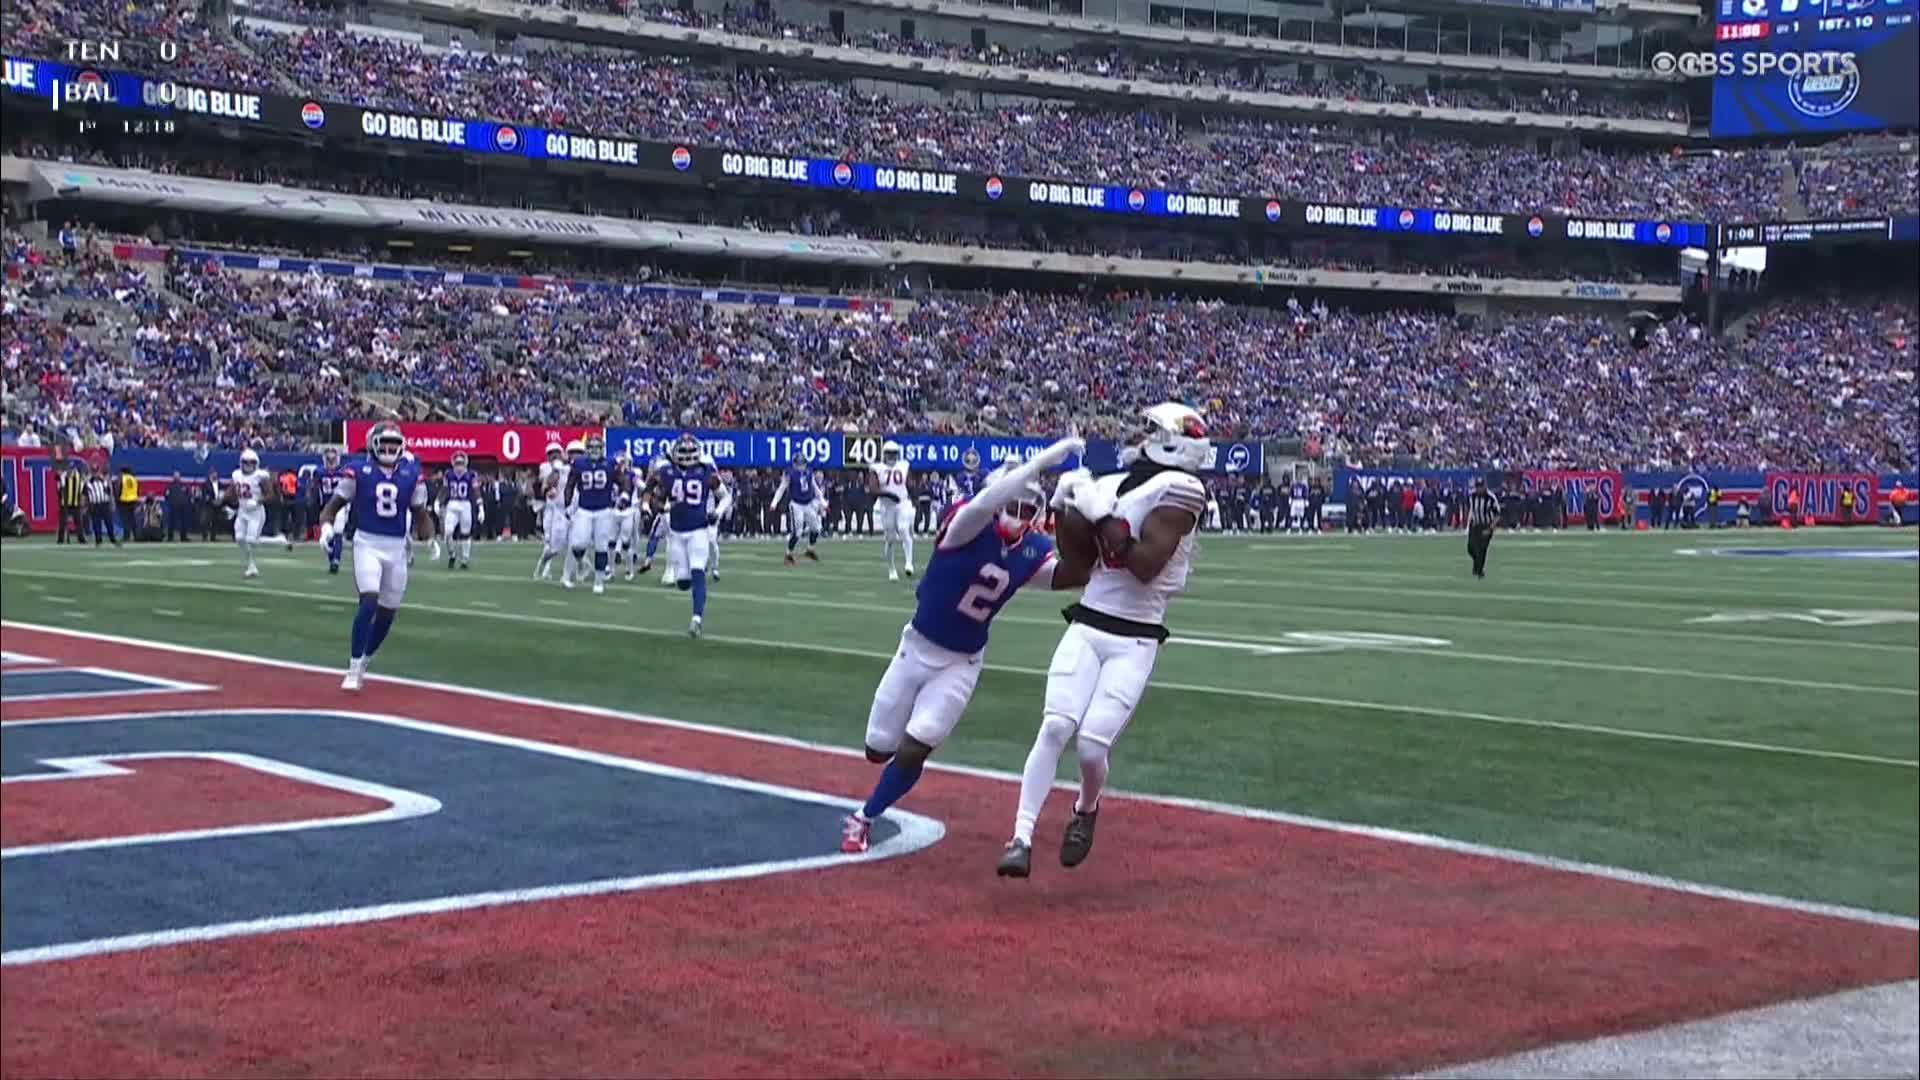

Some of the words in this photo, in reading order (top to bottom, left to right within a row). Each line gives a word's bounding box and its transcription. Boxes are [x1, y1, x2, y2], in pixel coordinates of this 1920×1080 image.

[0, 57, 36, 89] UE
[210, 90, 261, 121] BLUE
[361, 111, 387, 136] GO
[389, 114, 419, 140] BIG
[420, 118, 467, 147] BLUE
[545, 133, 569, 156] GO
[570, 136, 597, 160] BIG
[598, 139, 639, 165] BLUE
[721, 152, 743, 175] GO
[744, 155, 770, 177] BIG
[771, 157, 809, 181] BLUE
[875, 168, 896, 189] GO
[896, 169, 921, 191] BIG
[921, 172, 958, 195] BLUE
[1029, 182, 1048, 202] GO
[1049, 184, 1071, 204] BIG
[1071, 186, 1106, 208] BLUE
[1166, 193, 1185, 213] GO
[1186, 195, 1207, 215] BIG
[1207, 197, 1241, 218] BLUE
[1305, 204, 1324, 223] GO
[1324, 205, 1345, 224] BIG
[1346, 207, 1378, 227] BLUE
[1433, 213, 1451, 231] GO
[1452, 214, 1472, 232] BIG
[1472, 215, 1504, 234] BLUE
[1566, 220, 1584, 237] GO
[1584, 221, 1605, 238] BIG
[1605, 222, 1637, 241] BLUE
[406, 437, 477, 449] CARDINALS
[502, 430, 521, 461] 0
[624, 438, 656, 458] 1ST
[659, 440, 736, 459] QTER
[767, 436, 831, 463] 11:09
[849, 438, 877, 464] 40
[942, 445, 959, 461] 10
[990, 445, 1020, 462] BALL
[581, 469, 607, 490] 99
[671, 478, 703, 505] 49
[375, 481, 399, 518] 8
[956, 562, 1011, 623] 2
